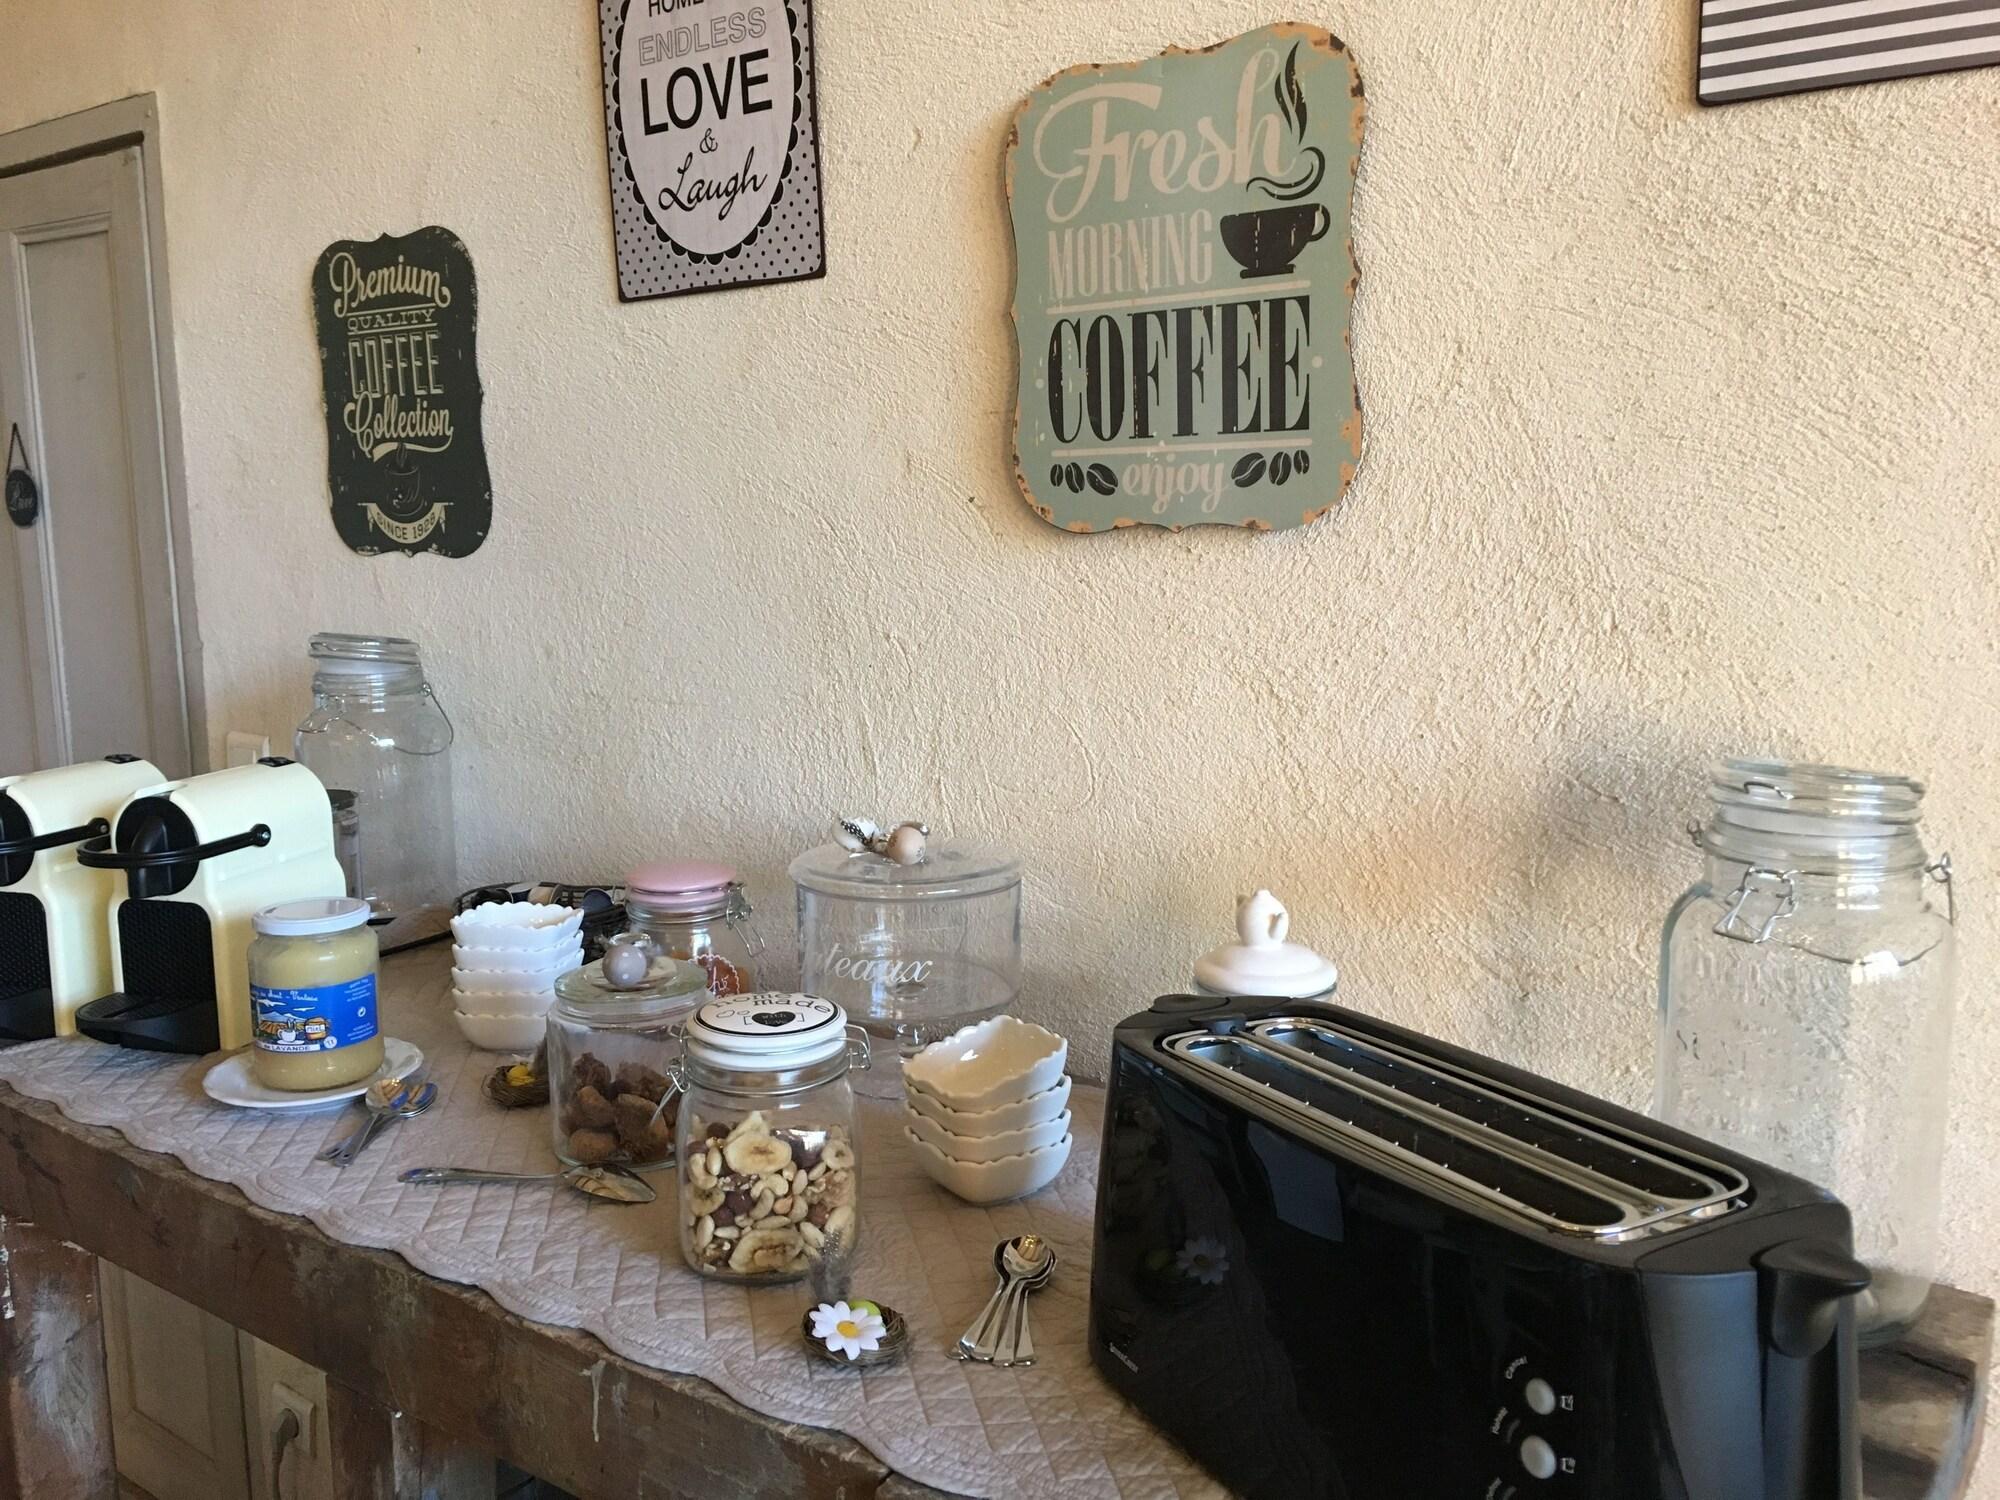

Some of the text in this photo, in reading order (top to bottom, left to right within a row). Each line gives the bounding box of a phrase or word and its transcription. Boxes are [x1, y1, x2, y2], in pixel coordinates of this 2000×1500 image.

[638, 6, 767, 66] ENDLESS
[648, 0, 704, 17] HO
[640, 48, 773, 136] LOVE
[699, 128, 718, 154] &
[1033, 48, 1300, 223] Fresh
[658, 146, 768, 221] Laugh
[329, 252, 451, 318] Premium
[1047, 208, 1213, 302] MORNING
[347, 308, 436, 332] QUALITY
[348, 329, 445, 399] COFFEE
[1047, 295, 1311, 444] COFFEE
[344, 391, 453, 459] Collection
[1122, 456, 1229, 514] enjoy
[376, 511, 409, 541] SINCE
[816, 942, 934, 984] teaux
[752, 998, 831, 1014] made
